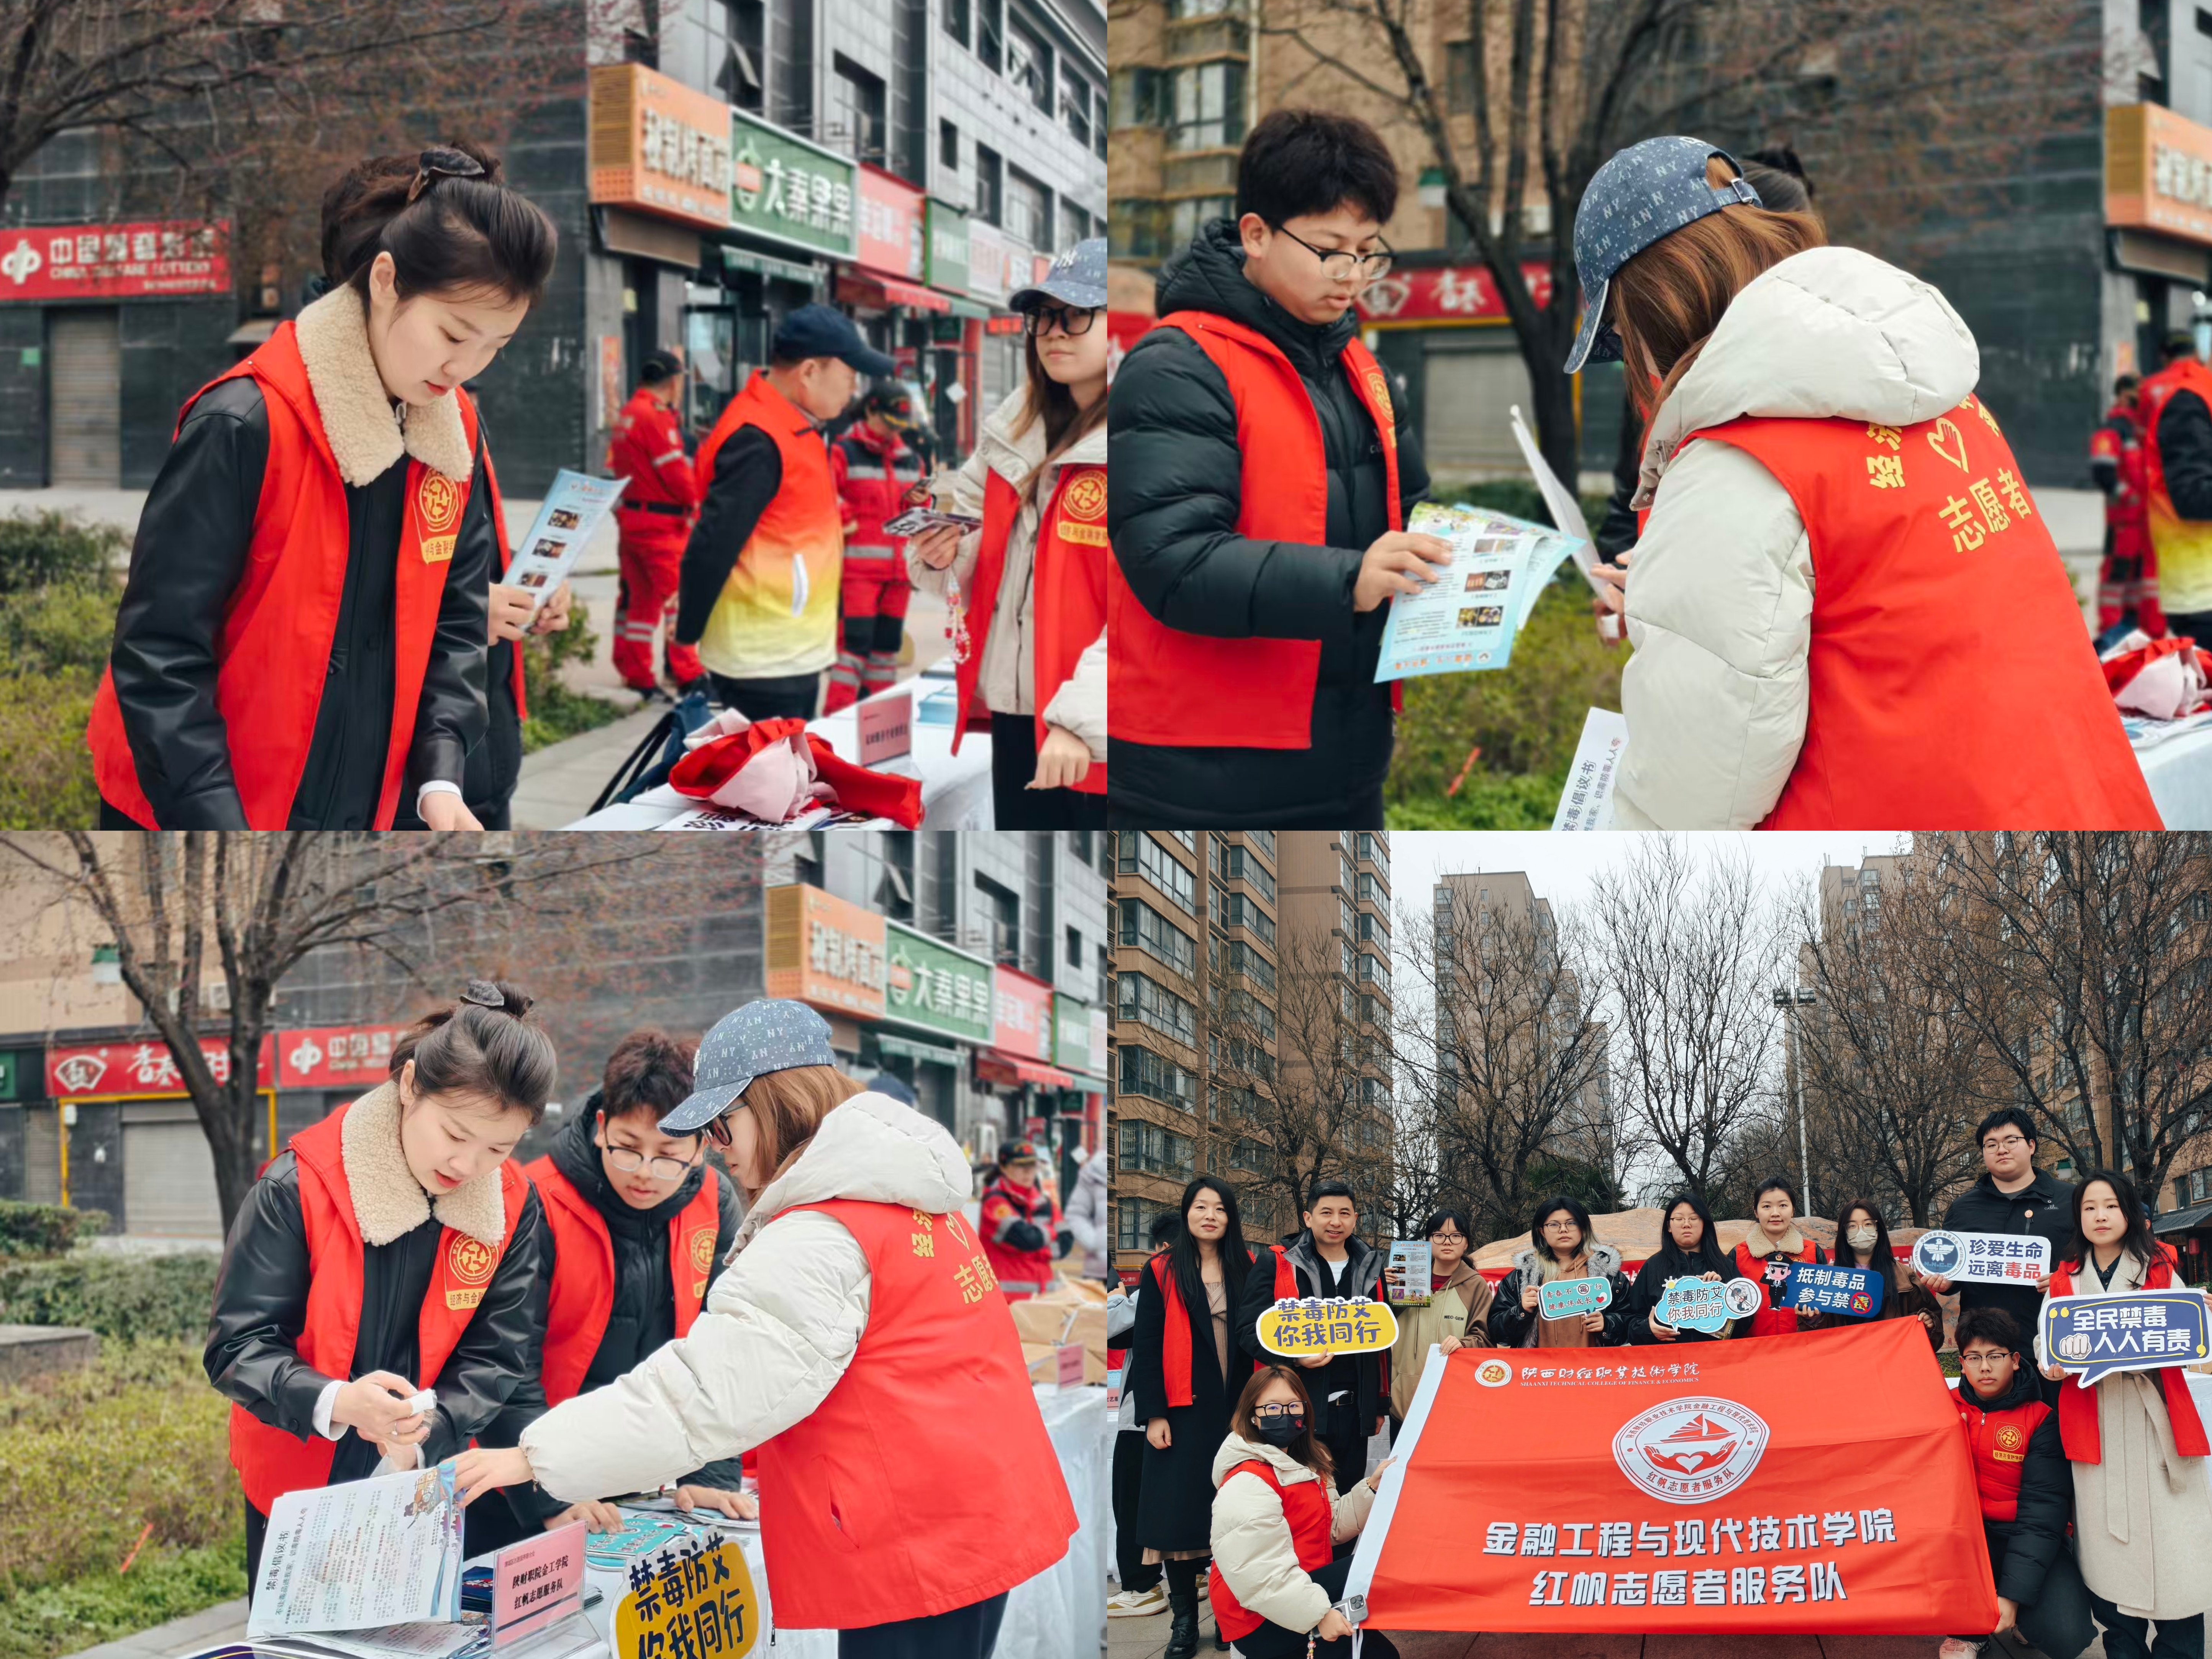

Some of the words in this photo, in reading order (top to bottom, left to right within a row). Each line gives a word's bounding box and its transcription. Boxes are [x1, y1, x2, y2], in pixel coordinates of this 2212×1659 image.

[1938, 468, 2032, 553] 志愿者
[1920, 1232, 1958, 1245] 中国国家禁毒委员会
[1969, 1239, 2043, 1259] 珍爱生命
[1797, 1267, 1866, 1291] 抵制毒品
[1968, 1259, 2041, 1280] 远离毒品
[1548, 1296, 1593, 1311] 健康伴成长
[1667, 1285, 1724, 1306] 禁毒防艾
[1798, 1287, 1869, 1311] 参与禁毒
[1278, 1299, 1371, 1322] 禁毒防艾
[1667, 1302, 1723, 1323] 你我同行
[2073, 1305, 2167, 1331] 全民禁毒
[1273, 1320, 1381, 1347] 你我同行
[2094, 1328, 2191, 1353] 人人有责
[1994, 1452, 2023, 1461] 经济与金融学院
[1646, 1467, 1735, 1493] 红帆志愿者服务队
[1482, 1507, 1896, 1557] 金融工程与现代技术学院
[266, 1531, 290, 1591] 禁毒倡议书
[629, 1532, 730, 1622] 禁毒防艾
[1528, 1560, 1847, 1606] 红帆志愿者服务队
[514, 1578, 563, 1610] 红帆志愿服务队
